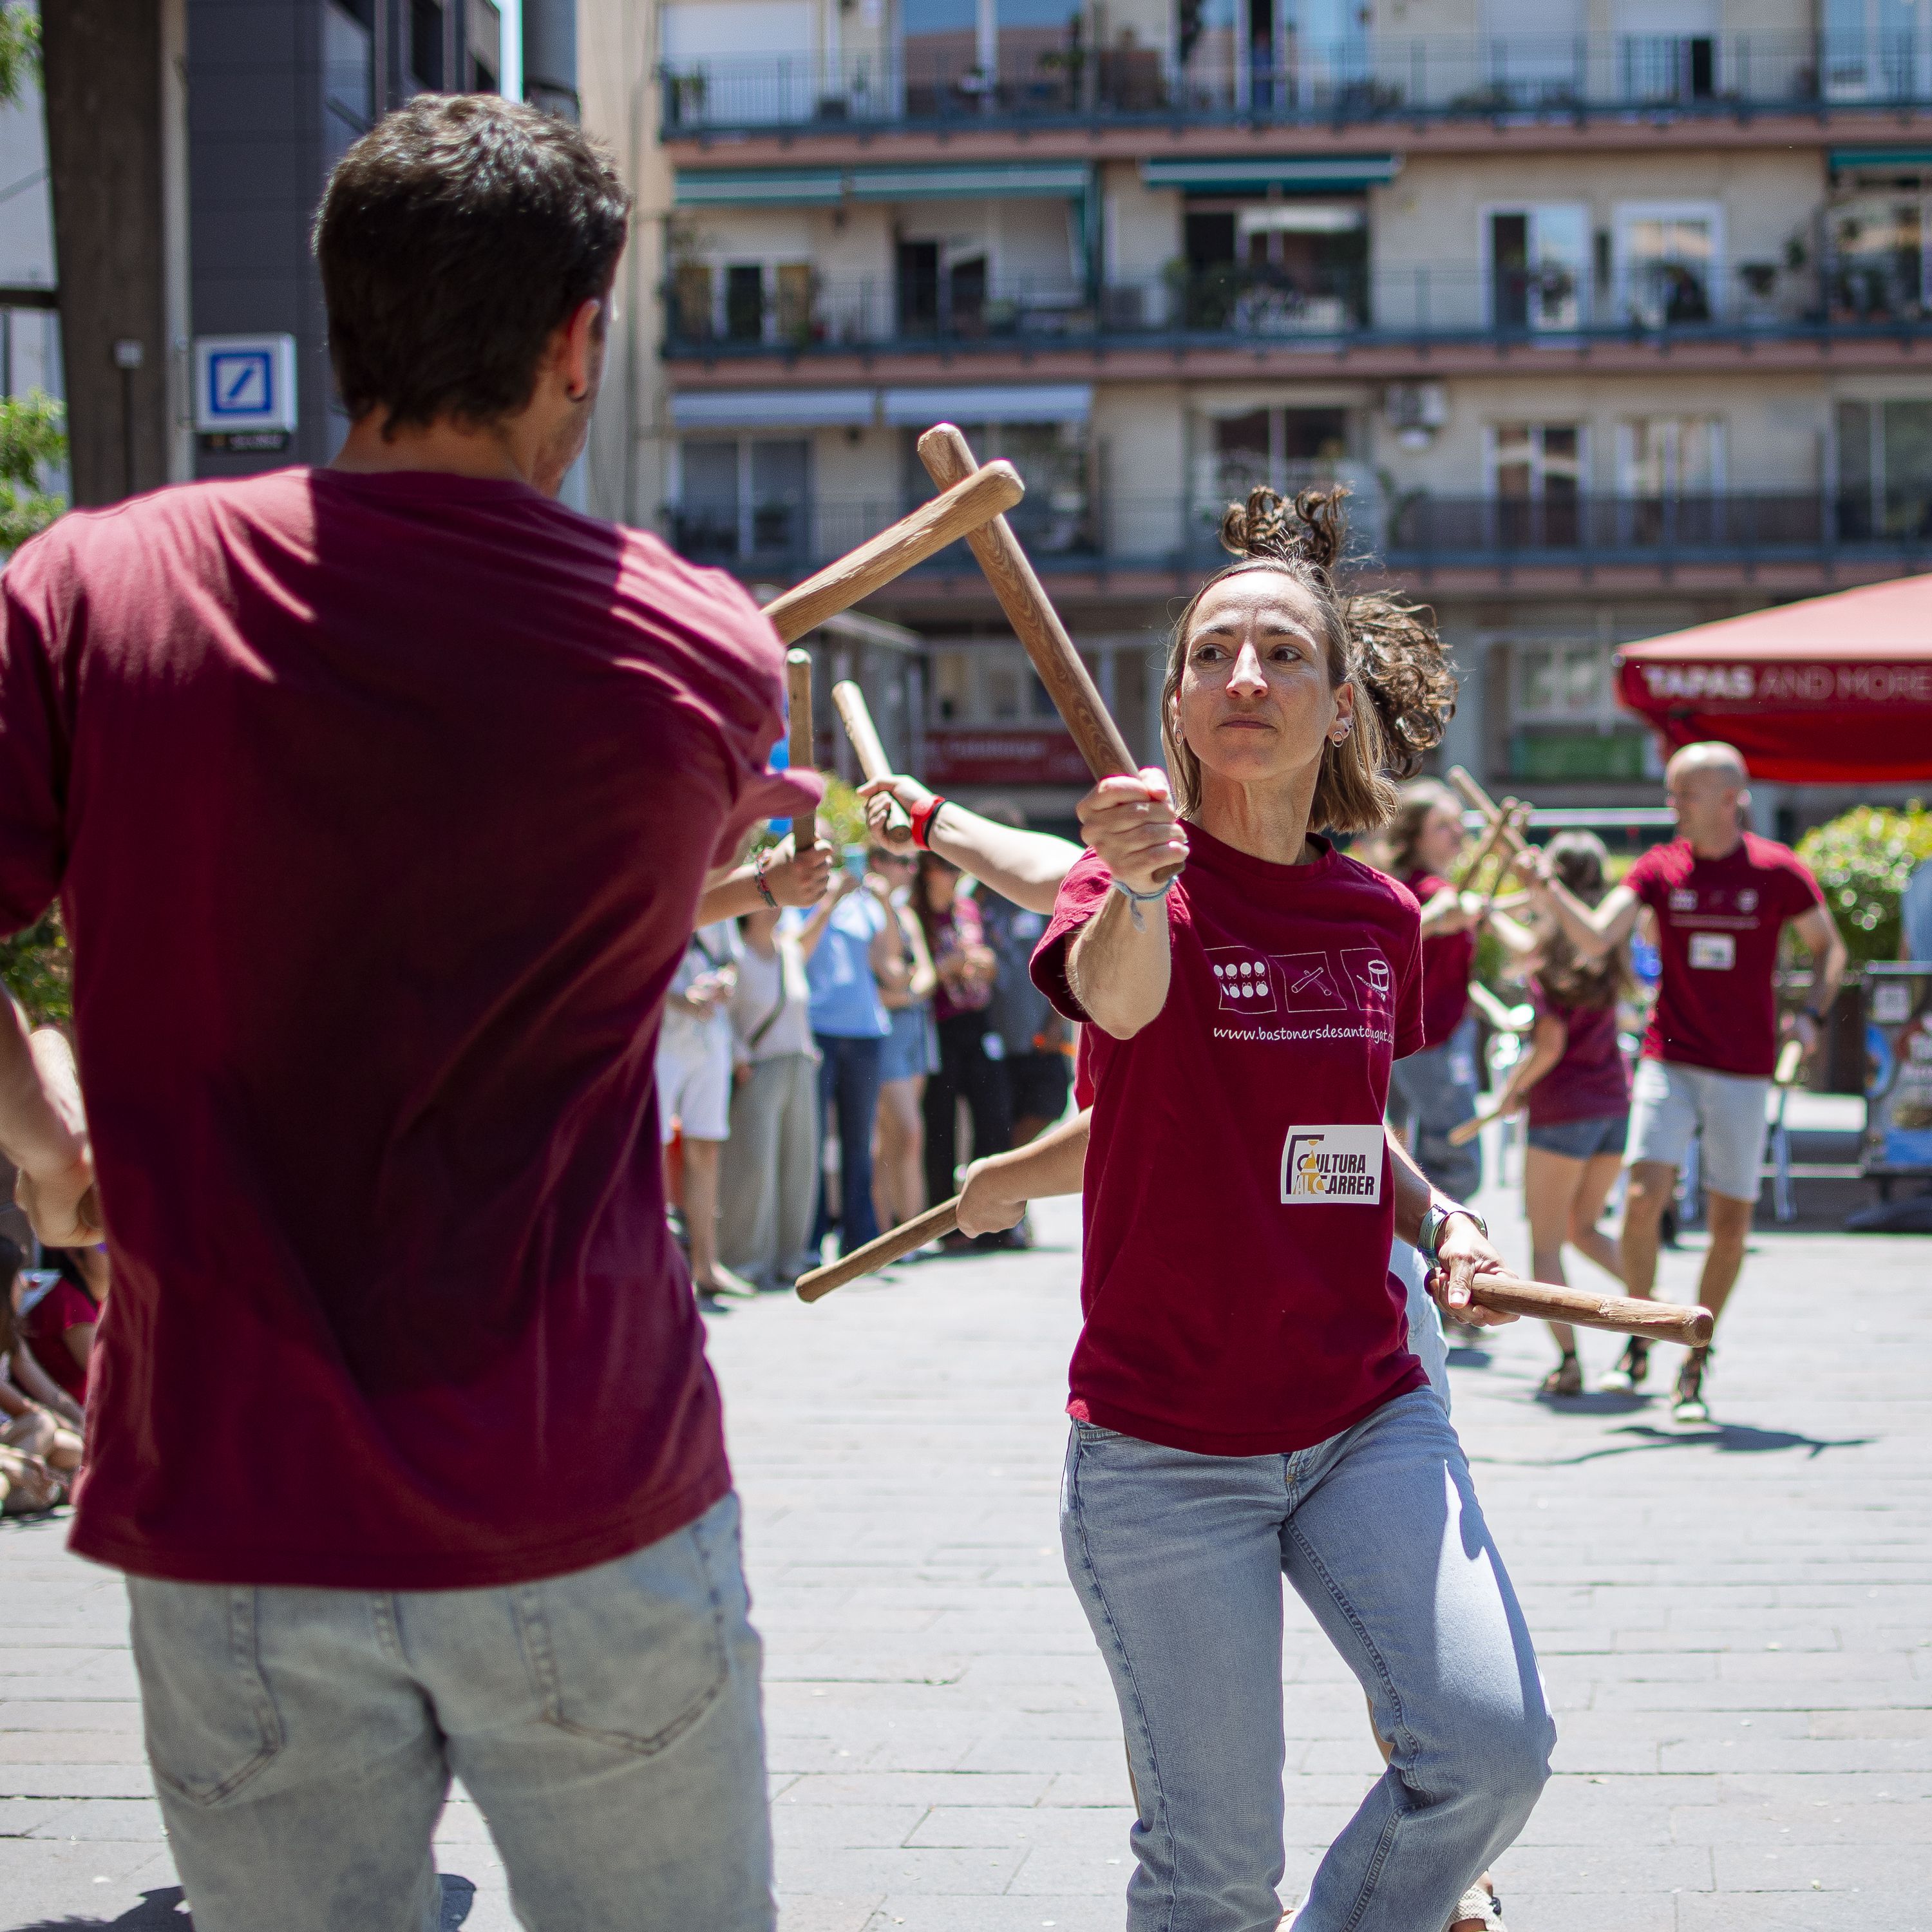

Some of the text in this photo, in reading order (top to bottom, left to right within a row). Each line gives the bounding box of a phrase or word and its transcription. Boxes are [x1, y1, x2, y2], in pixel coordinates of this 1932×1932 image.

[1643, 666, 1754, 699] TAPAS
[1759, 666, 1835, 699] AND
[1296, 1153, 1366, 1173] CULTURA
[1312, 1175, 1374, 1195] CARRER
